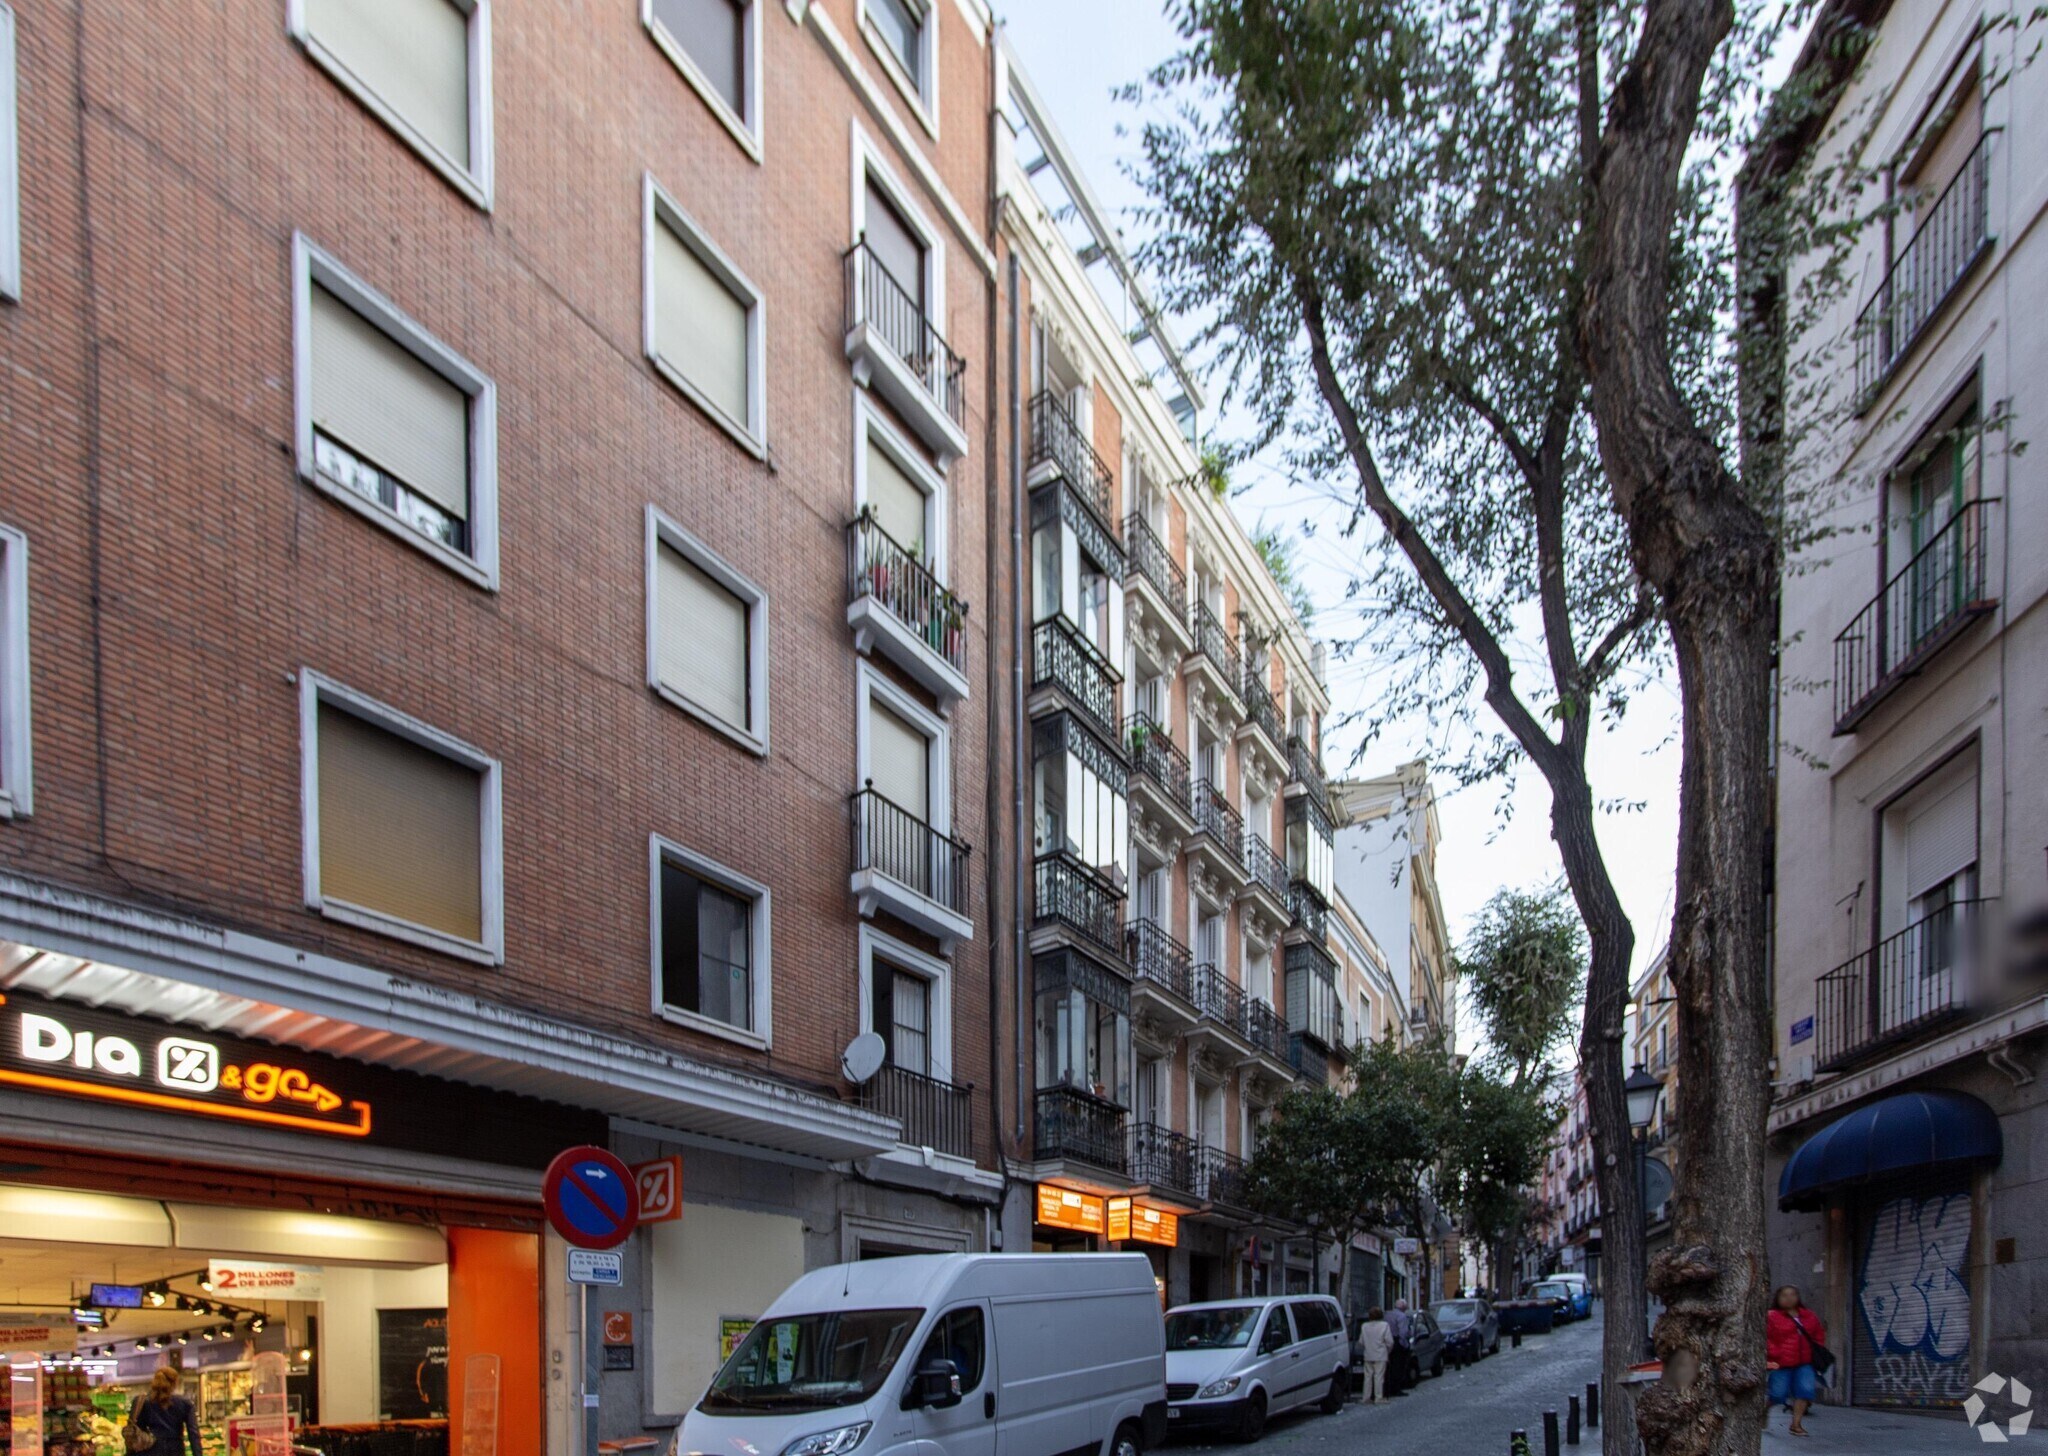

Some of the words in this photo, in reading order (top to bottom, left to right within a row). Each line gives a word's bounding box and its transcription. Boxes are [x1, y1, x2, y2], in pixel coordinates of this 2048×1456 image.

[216, 1269, 237, 1289] 2
[238, 1271, 296, 1279] MILLONES
[258, 1279, 295, 1287] EUROS
